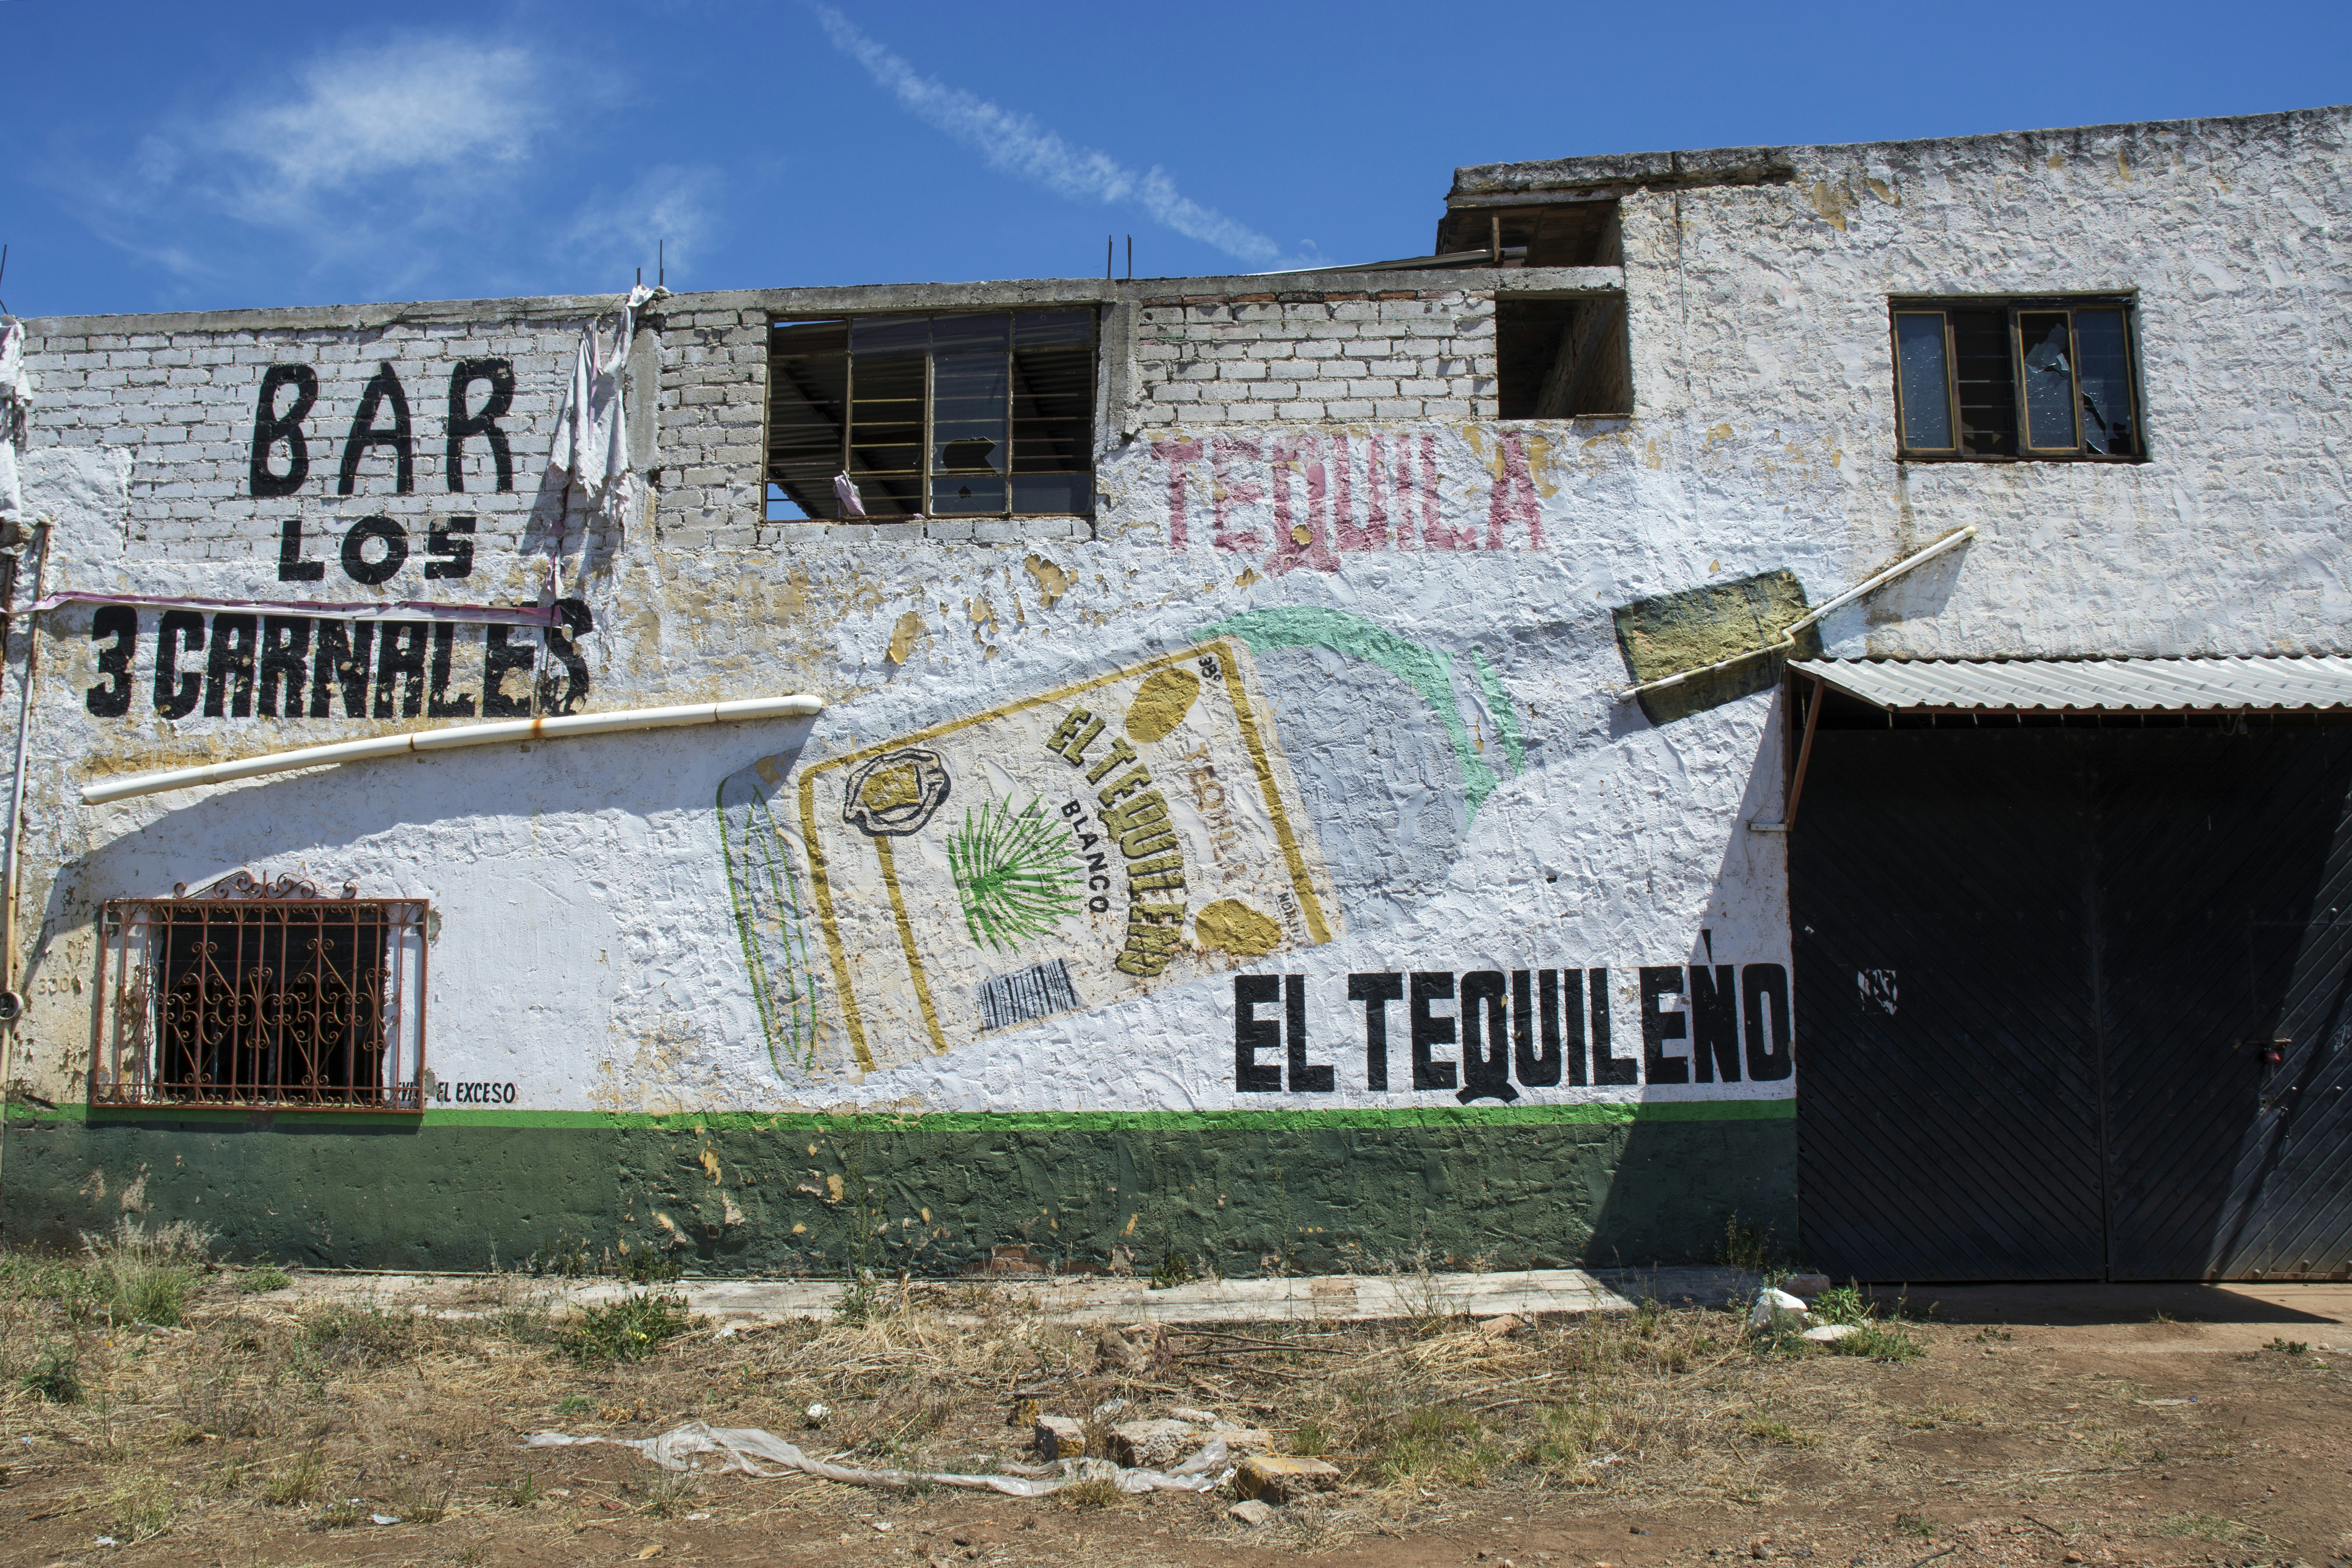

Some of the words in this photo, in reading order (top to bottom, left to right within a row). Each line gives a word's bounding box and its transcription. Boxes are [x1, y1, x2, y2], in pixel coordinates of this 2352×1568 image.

[250, 358, 515, 497] BAR
[278, 515, 476, 585] LOS
[1151, 430, 1545, 576] TEQUILA
[87, 606, 138, 718] 3
[152, 597, 592, 720] CARNALES
[1046, 706, 1106, 767] EL
[1061, 799, 1110, 913] BLANCO
[1234, 974, 1334, 1093] EL
[437, 1082, 451, 1102] EL
[456, 1082, 515, 1103] EXCESO
